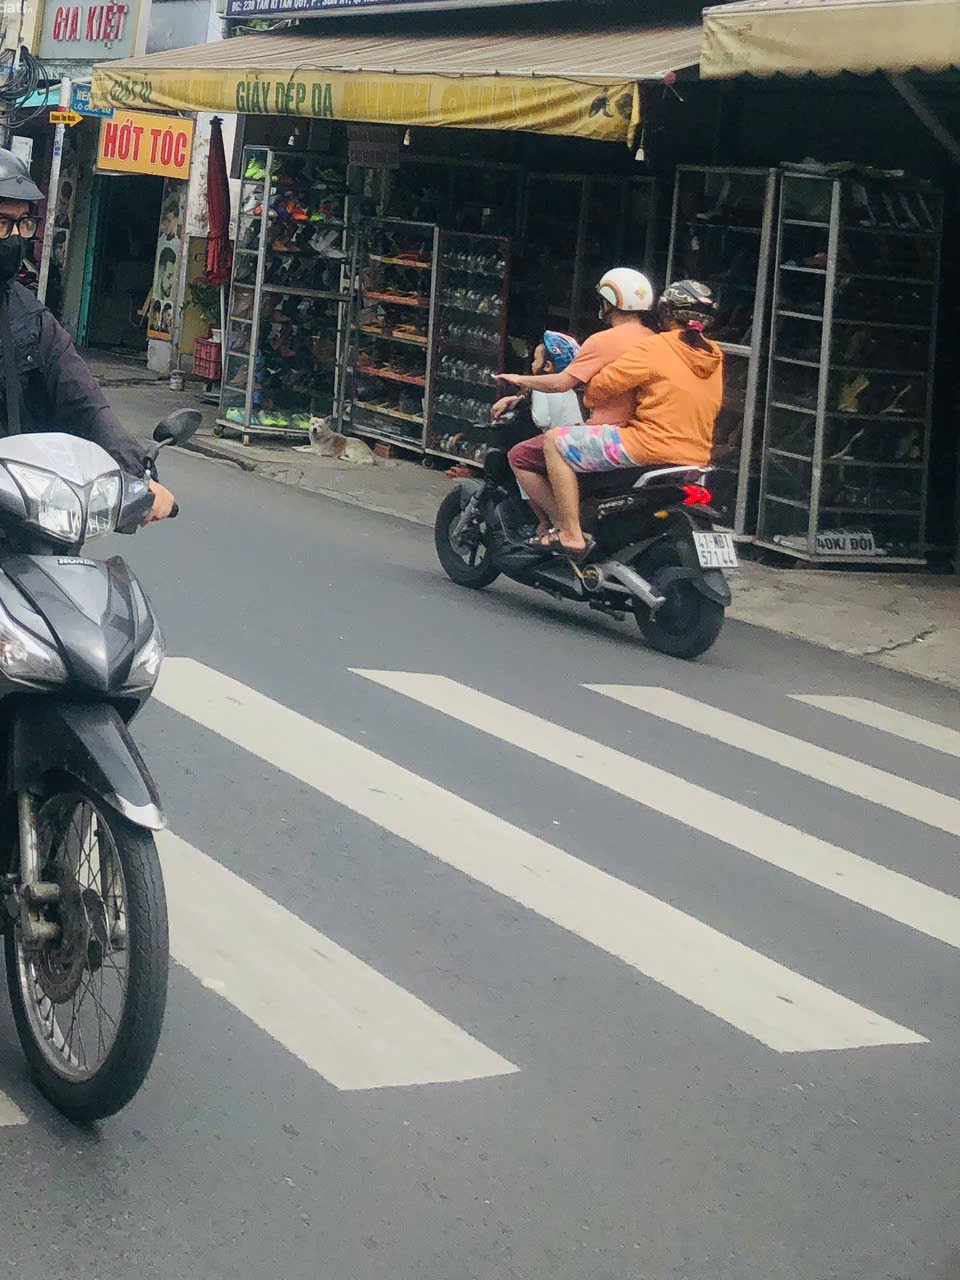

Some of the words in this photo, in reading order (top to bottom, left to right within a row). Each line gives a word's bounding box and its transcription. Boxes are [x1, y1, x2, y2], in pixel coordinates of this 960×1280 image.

[53, 6, 83, 42] GIA
[236, 73, 272, 114] GIÀY
[275, 77, 307, 116] DÉP
[310, 82, 336, 119] DA
[103, 118, 144, 161] HỚT
[149, 124, 188, 168] TÓC
